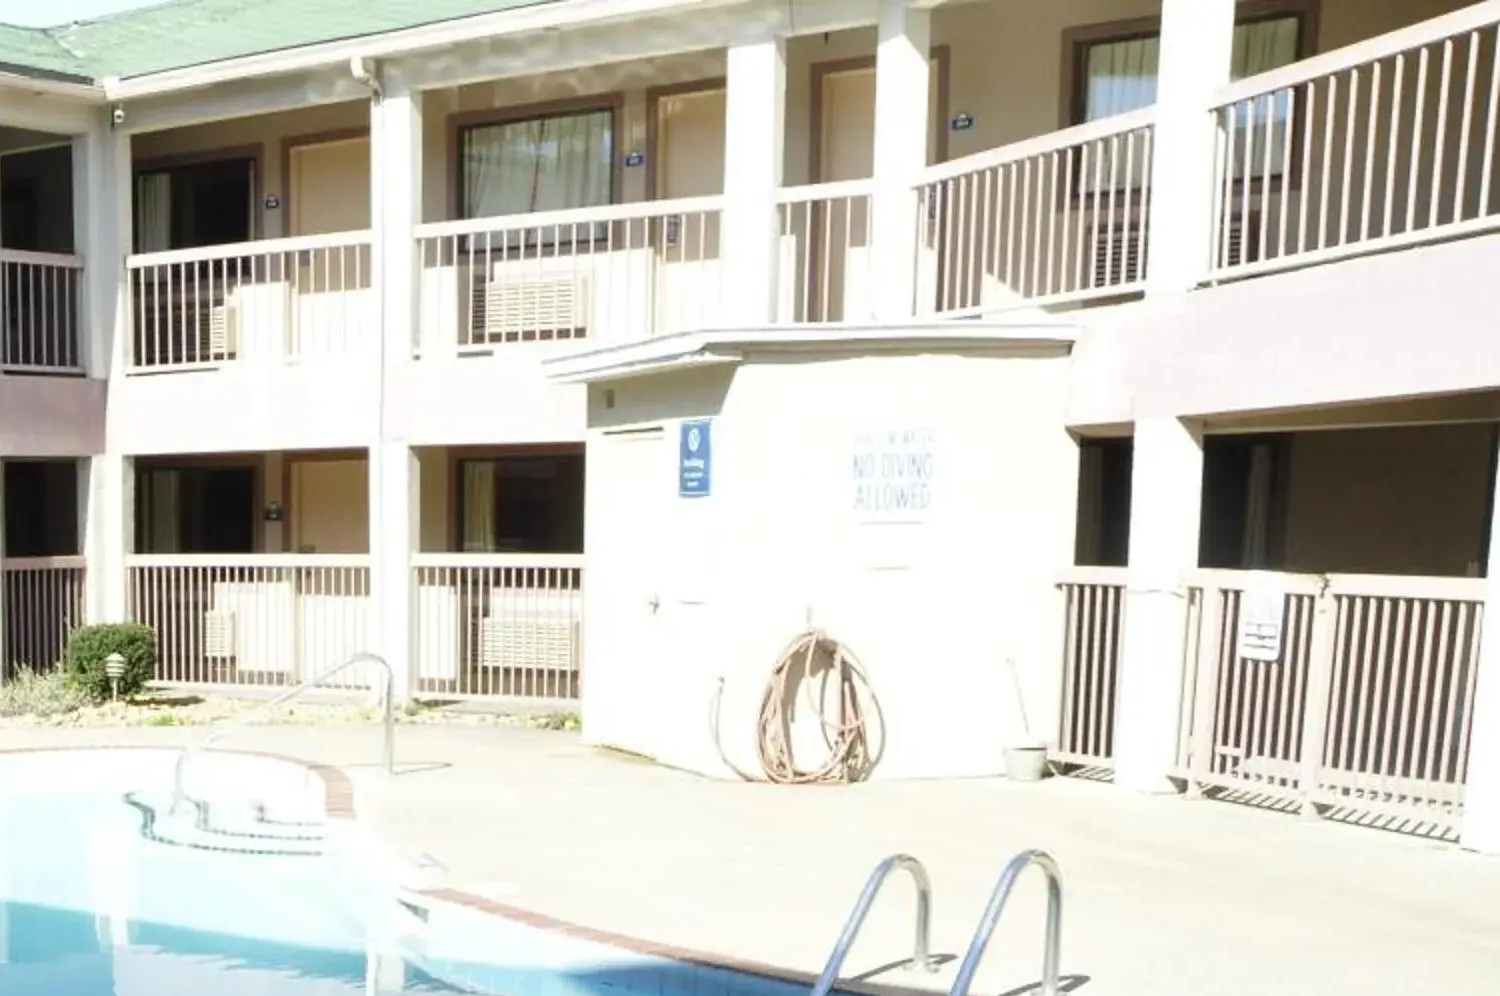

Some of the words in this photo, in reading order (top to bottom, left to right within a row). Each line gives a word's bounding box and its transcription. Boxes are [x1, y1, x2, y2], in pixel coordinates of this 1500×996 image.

[853, 452, 876, 480] NO
[881, 452, 934, 480] DIVING
[853, 483, 932, 510] ALLOWED
